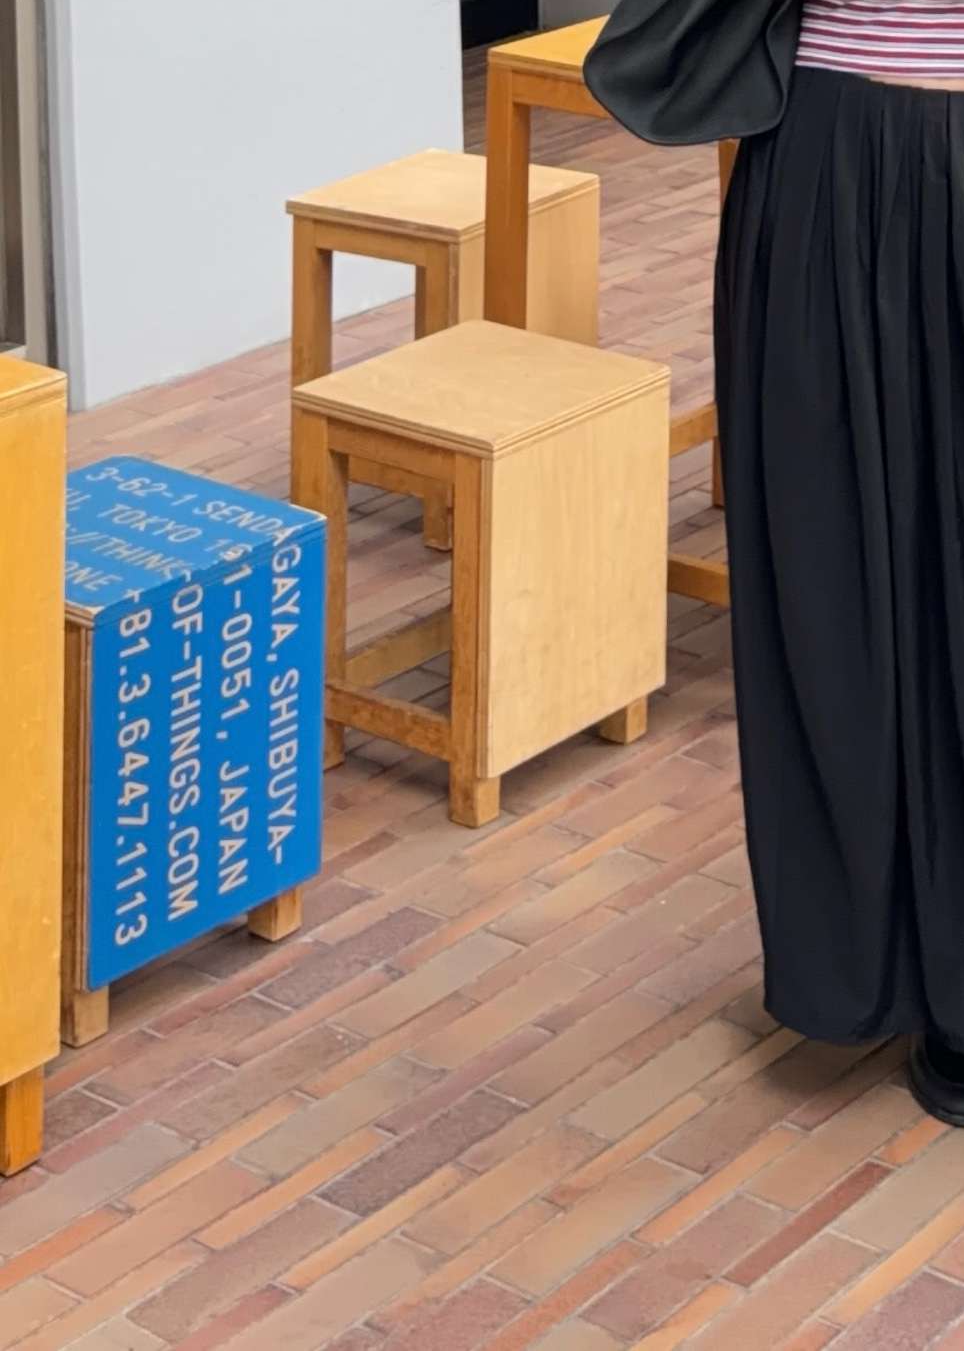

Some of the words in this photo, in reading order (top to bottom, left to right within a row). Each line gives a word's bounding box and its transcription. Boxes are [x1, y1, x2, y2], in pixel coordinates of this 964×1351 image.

[85, 467, 198, 507] 3-62-1
[193, 500, 304, 663] SENDAGAYA,
[267, 668, 299, 864] SHIBUYA-
[96, 503, 203, 543] TOKYO
[218, 760, 250, 895] JAPAN
[114, 587, 153, 946] +81.3.6447.1113
